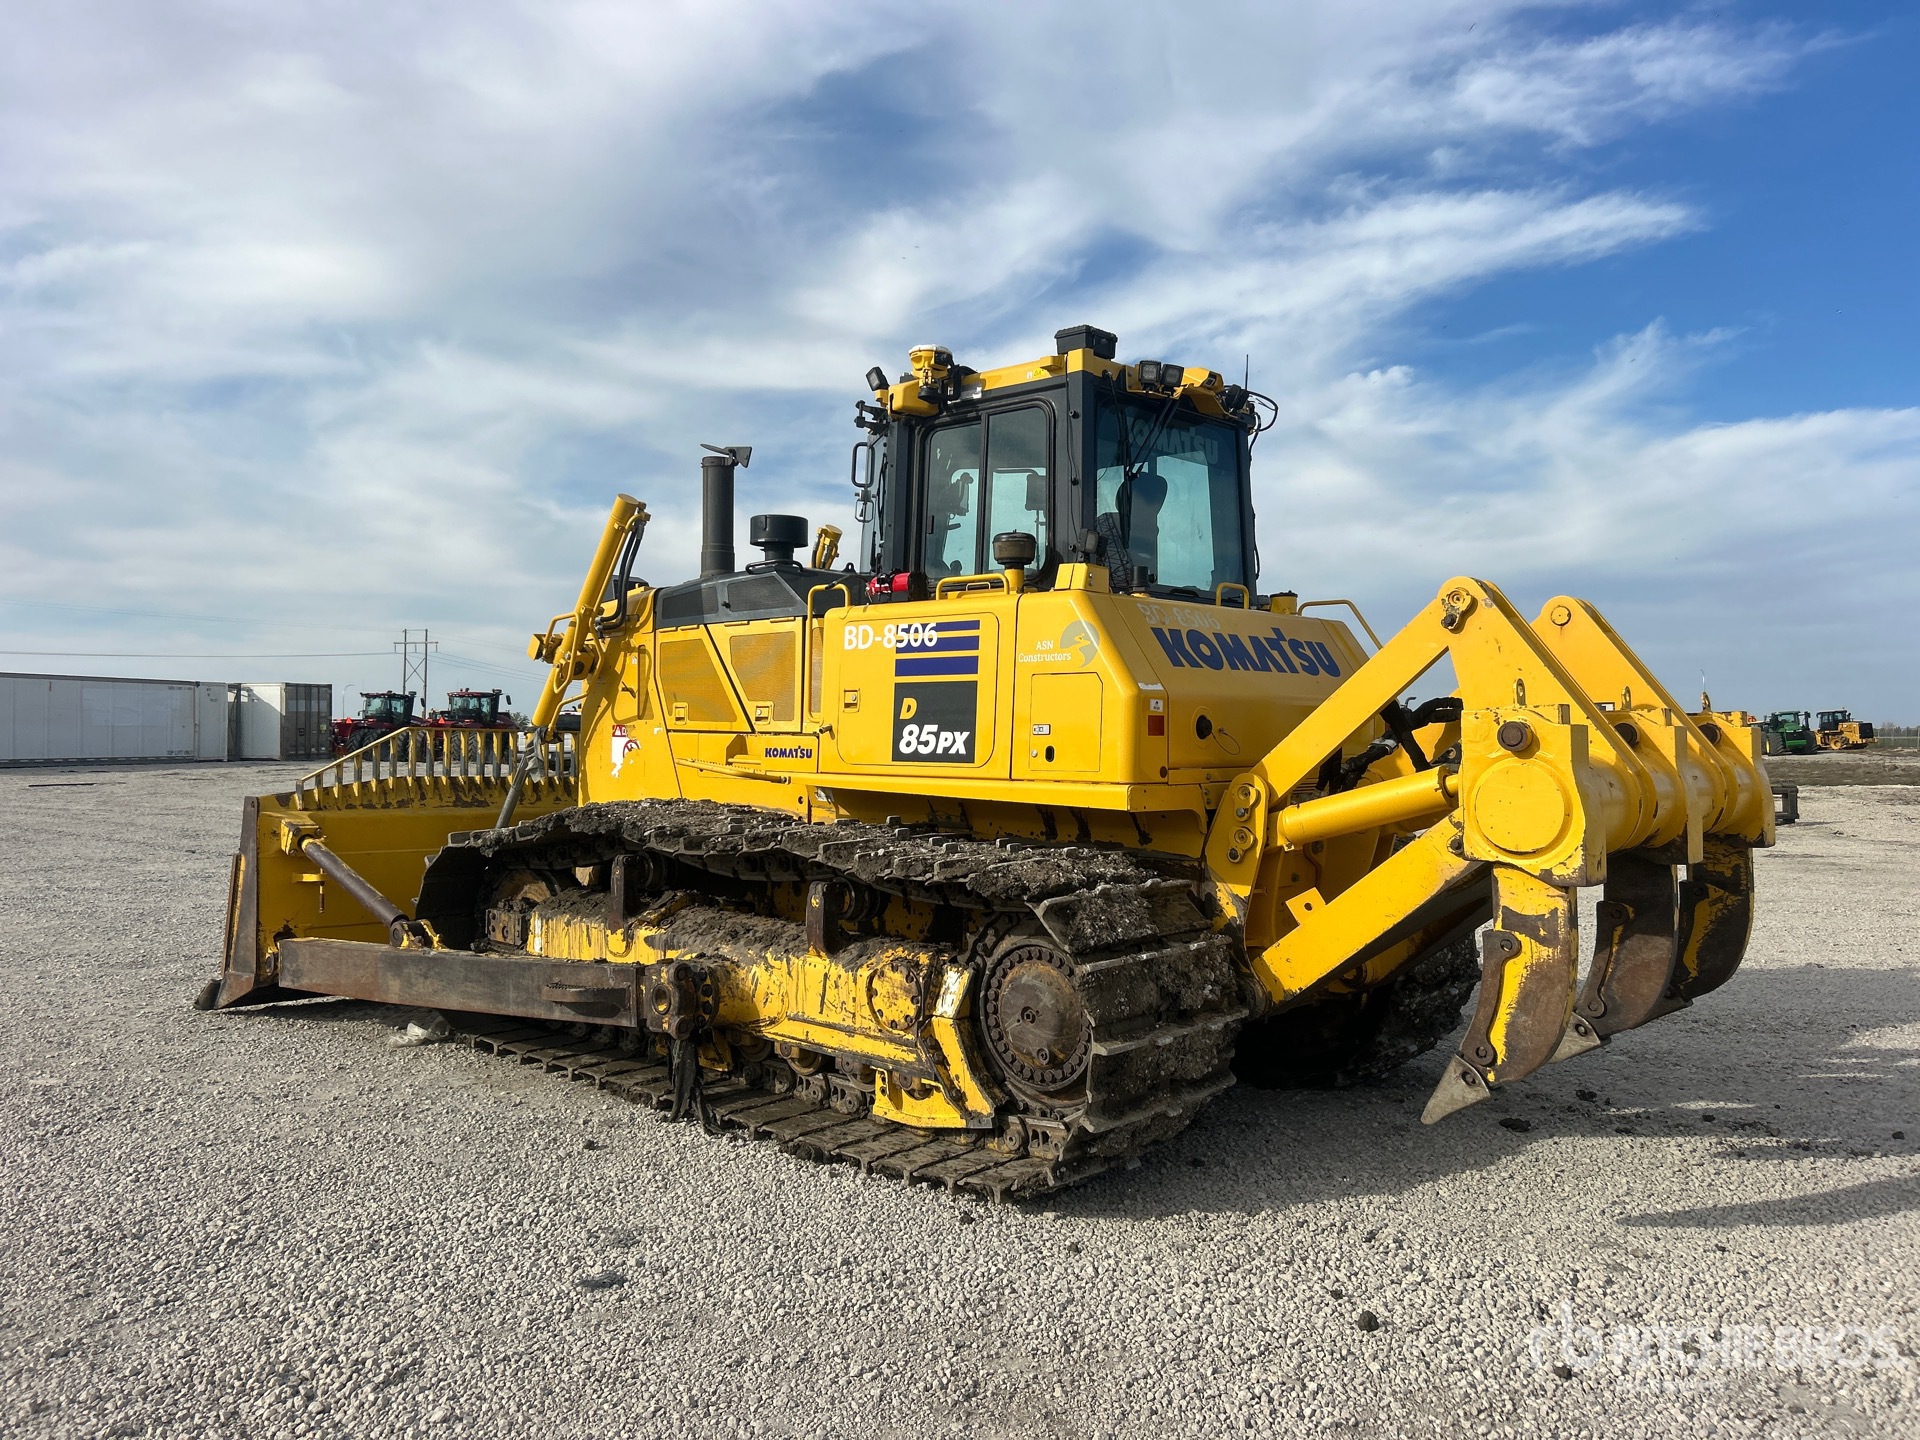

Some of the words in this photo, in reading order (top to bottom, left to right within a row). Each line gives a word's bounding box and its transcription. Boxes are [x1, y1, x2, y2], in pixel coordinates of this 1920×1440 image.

[843, 622, 938, 650] BD-8506
[1035, 640, 1054, 650] ASN
[1018, 652, 1072, 663] Constructors
[1151, 627, 1341, 678] KOMATSU
[899, 698, 917, 720] D
[898, 723, 970, 755] 85PX
[764, 745, 813, 759] KOMATSU
